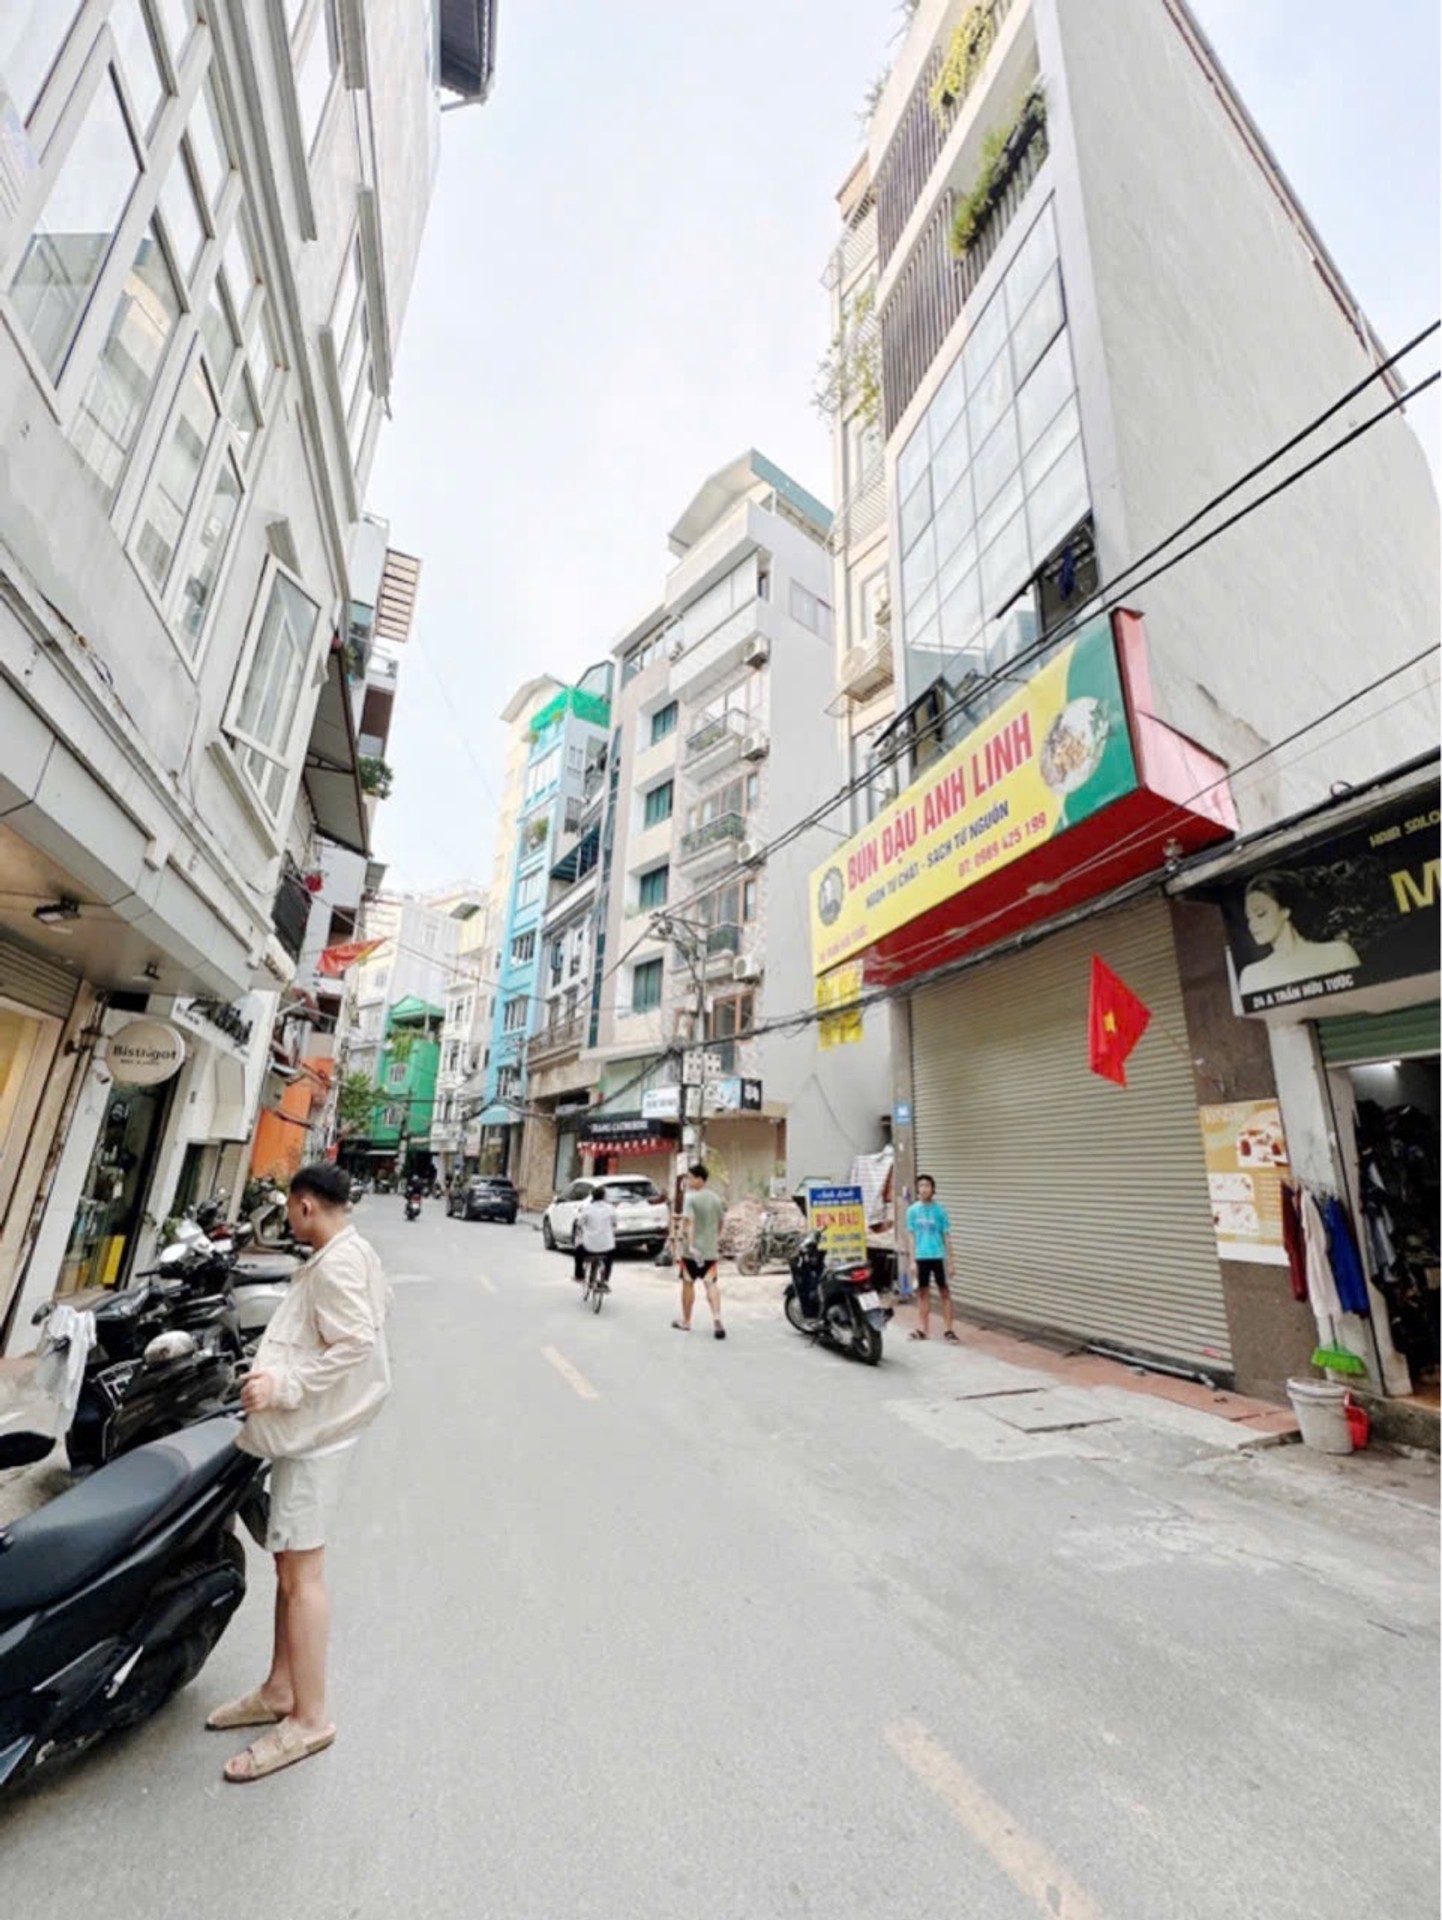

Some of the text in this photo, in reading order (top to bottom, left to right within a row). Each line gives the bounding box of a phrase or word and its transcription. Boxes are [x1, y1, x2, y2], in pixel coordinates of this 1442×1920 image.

[848, 711, 1033, 892] BÚN ĐẬU ANH LINH
